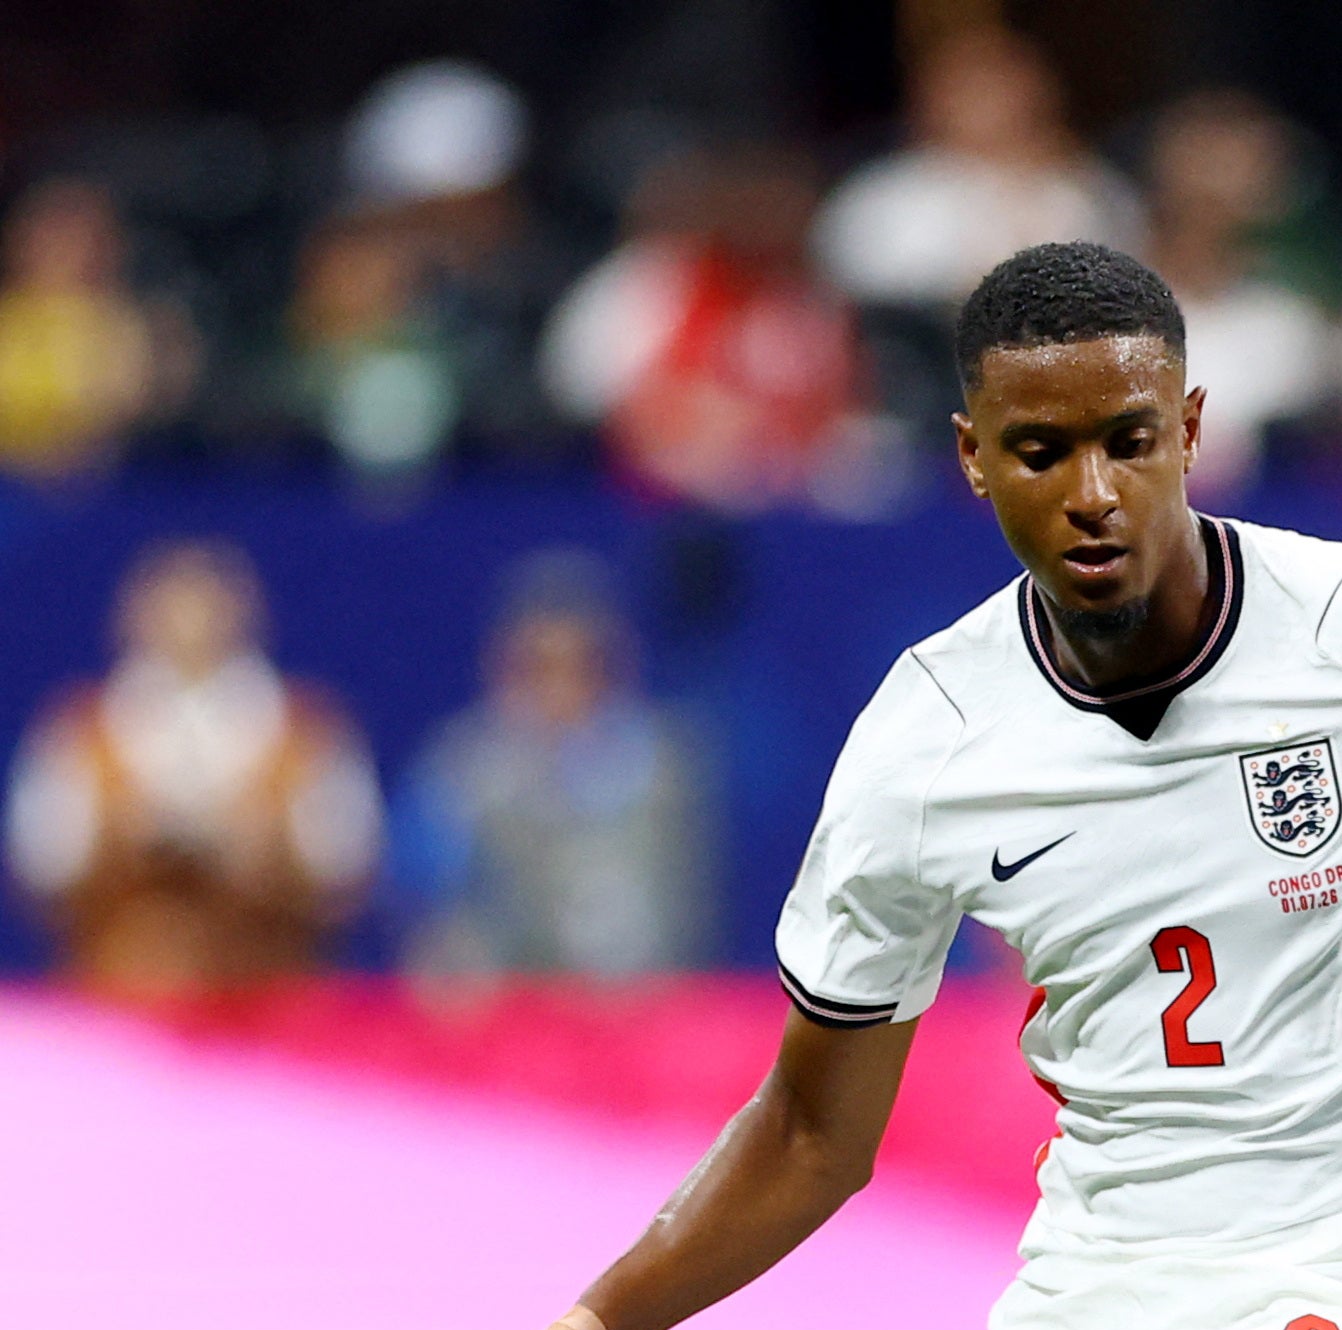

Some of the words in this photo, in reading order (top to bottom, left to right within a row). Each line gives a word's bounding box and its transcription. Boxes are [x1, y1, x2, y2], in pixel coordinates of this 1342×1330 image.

[1268, 871, 1322, 897] CONGO
[1281, 888, 1338, 913] 01.07.26
[1148, 925, 1226, 1068] 2
